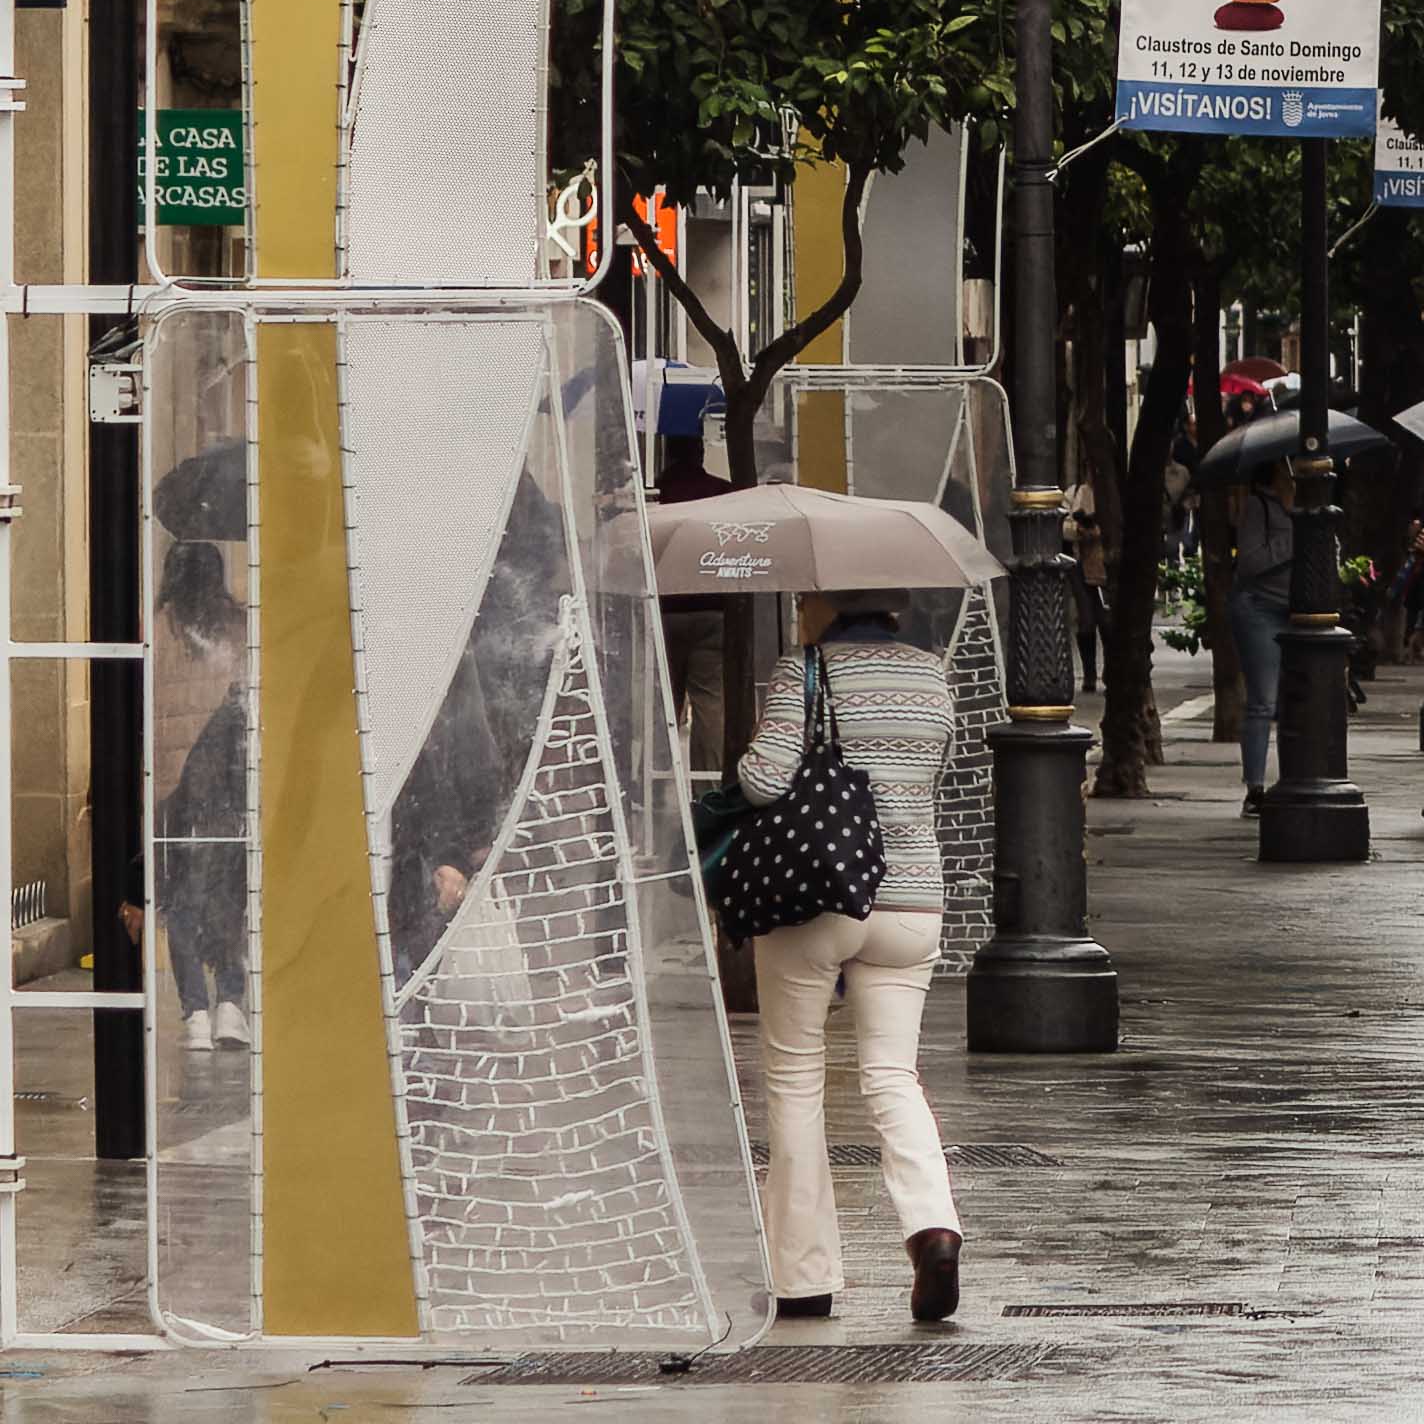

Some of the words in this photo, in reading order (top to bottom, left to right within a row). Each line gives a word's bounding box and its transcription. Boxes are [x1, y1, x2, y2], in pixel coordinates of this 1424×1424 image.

[1136, 35, 1212, 55] Claustros
[1217, 39, 1236, 55] de
[1240, 40, 1285, 57] Santo
[1290, 41, 1362, 62] Domingo
[1151, 61, 1173, 79] 11,
[1179, 62, 1197, 78] 12
[1201, 66, 1211, 82] y
[1216, 64, 1233, 80] 13
[1238, 64, 1256, 81] de
[1261, 65, 1345, 83] noviembre
[1130, 88, 1272, 121] ¡VISÍTANOS!
[169, 128, 236, 149] CASA
[177, 156, 228, 178] LAS
[1398, 157, 1414, 169] 11,
